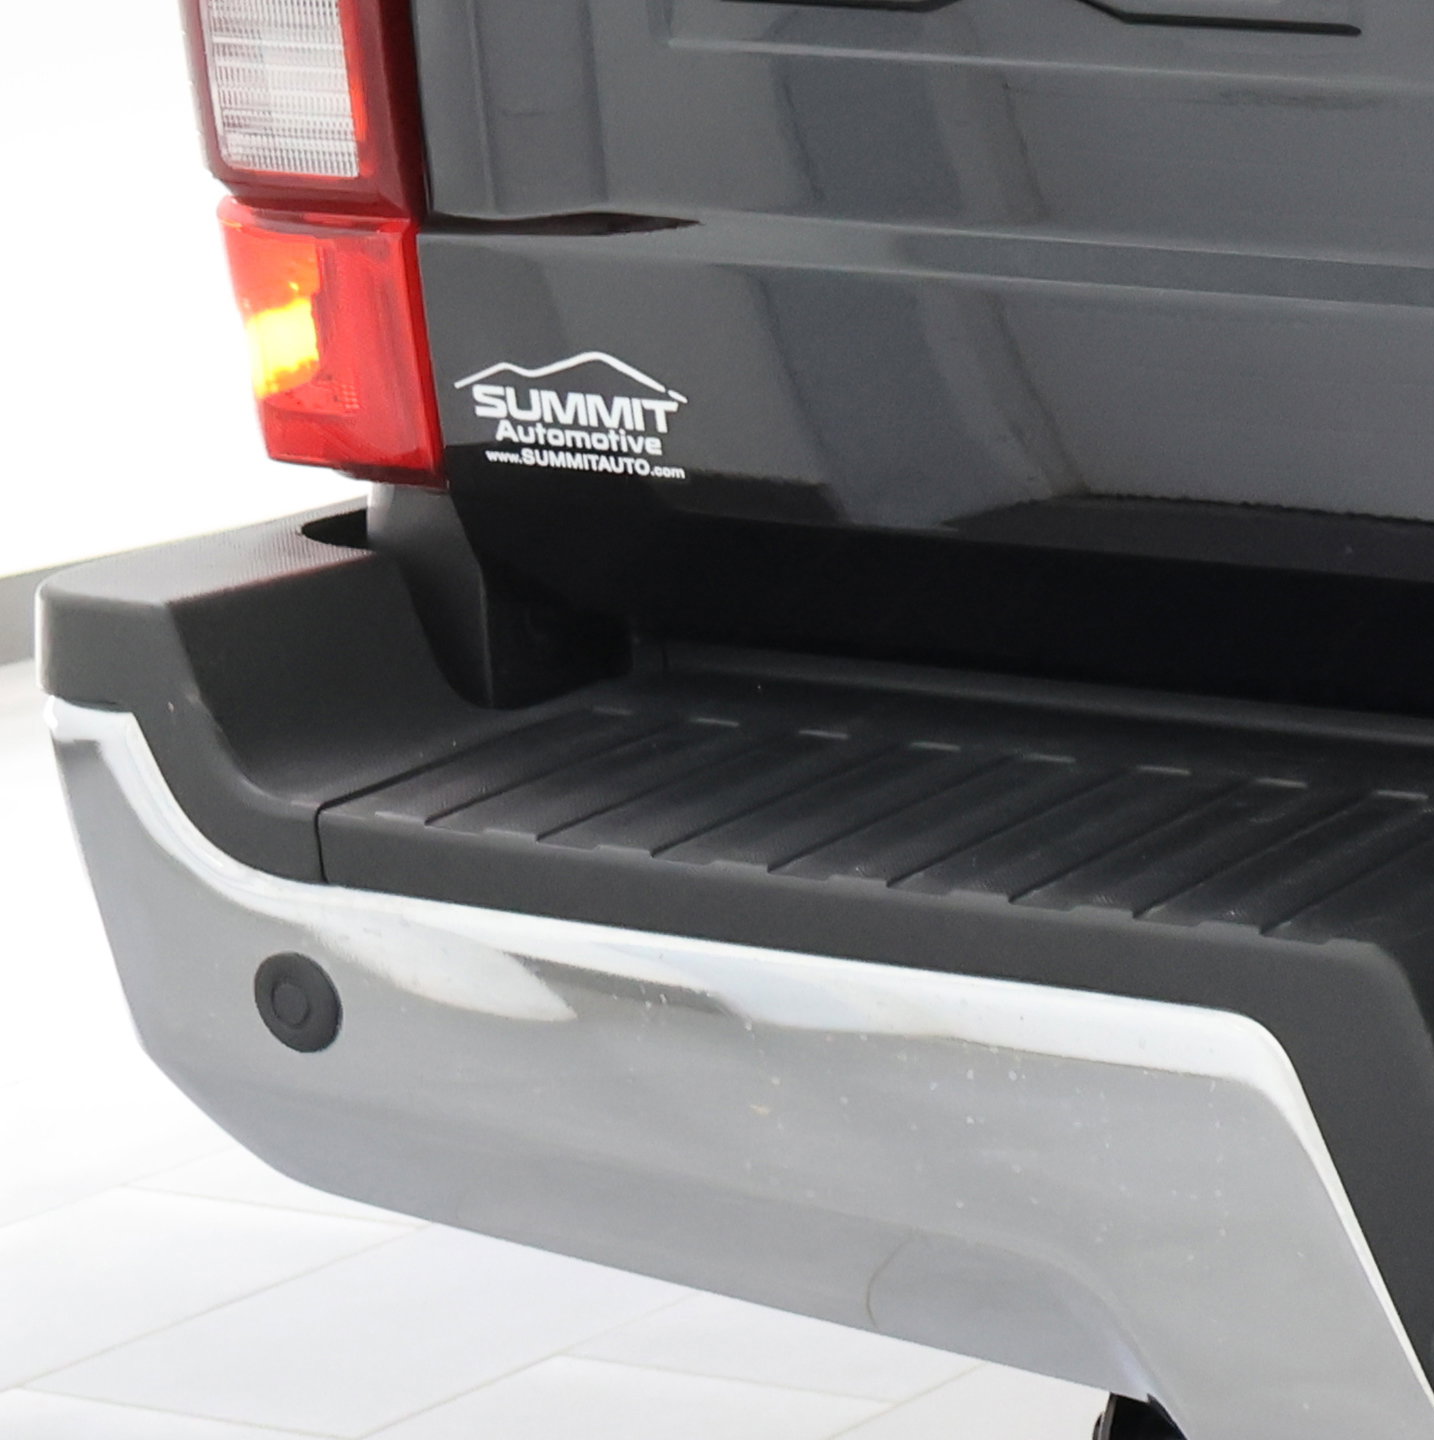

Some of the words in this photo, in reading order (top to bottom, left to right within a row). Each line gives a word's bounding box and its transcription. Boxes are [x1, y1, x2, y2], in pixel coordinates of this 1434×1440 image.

[472, 384, 679, 434] SUMMIT
[496, 419, 663, 456] Automotive
[485, 448, 686, 479] www.SUMMITAUTO.com
